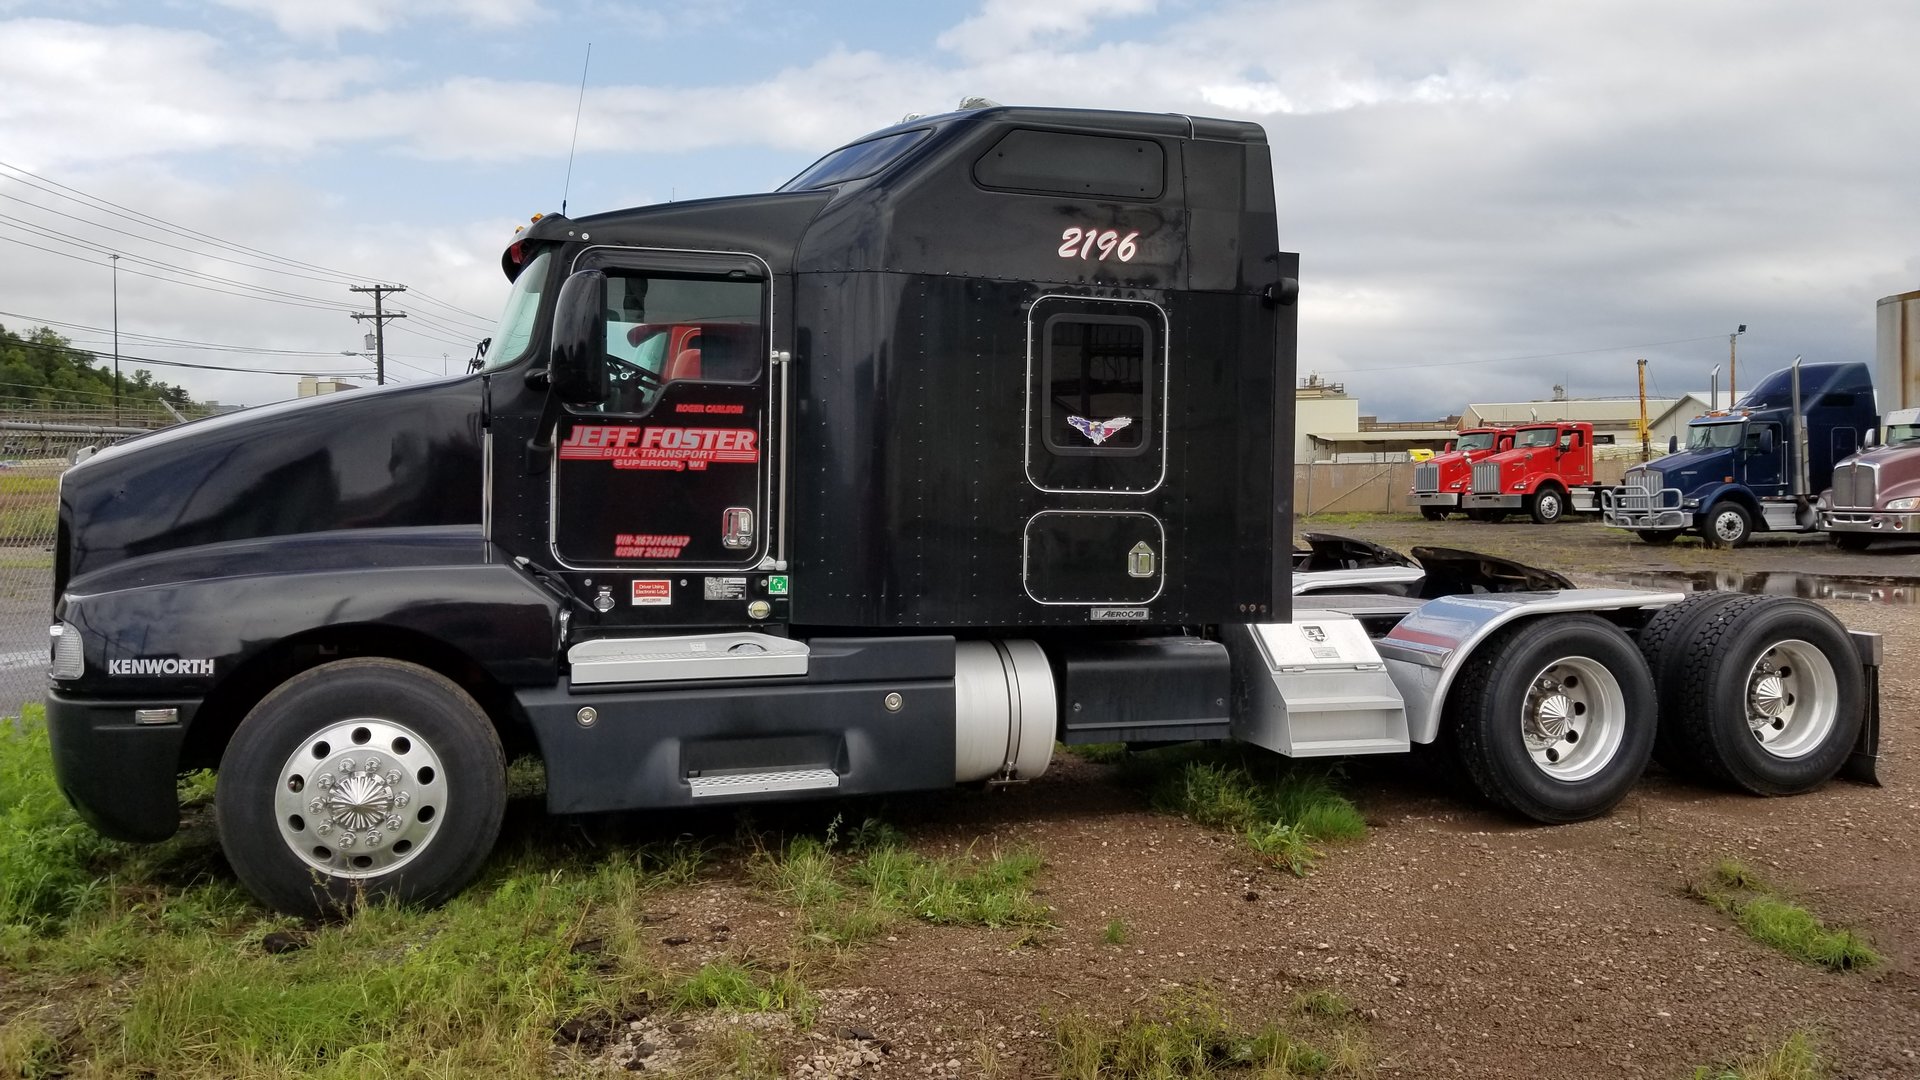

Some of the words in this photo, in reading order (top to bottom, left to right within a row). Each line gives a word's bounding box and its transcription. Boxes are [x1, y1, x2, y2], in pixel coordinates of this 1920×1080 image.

[1058, 227, 1139, 262] 2196
[676, 404, 705, 413] ROGER
[562, 425, 639, 448] JEFF
[643, 428, 755, 451] FOSTER
[603, 449, 638, 459] BULK
[641, 449, 716, 460] TRANSPORT
[613, 458, 683, 469] SUPERIOR,
[687, 461, 705, 469] WI
[616, 546, 645, 557] USDOT
[108, 658, 215, 675] KENWORTH
